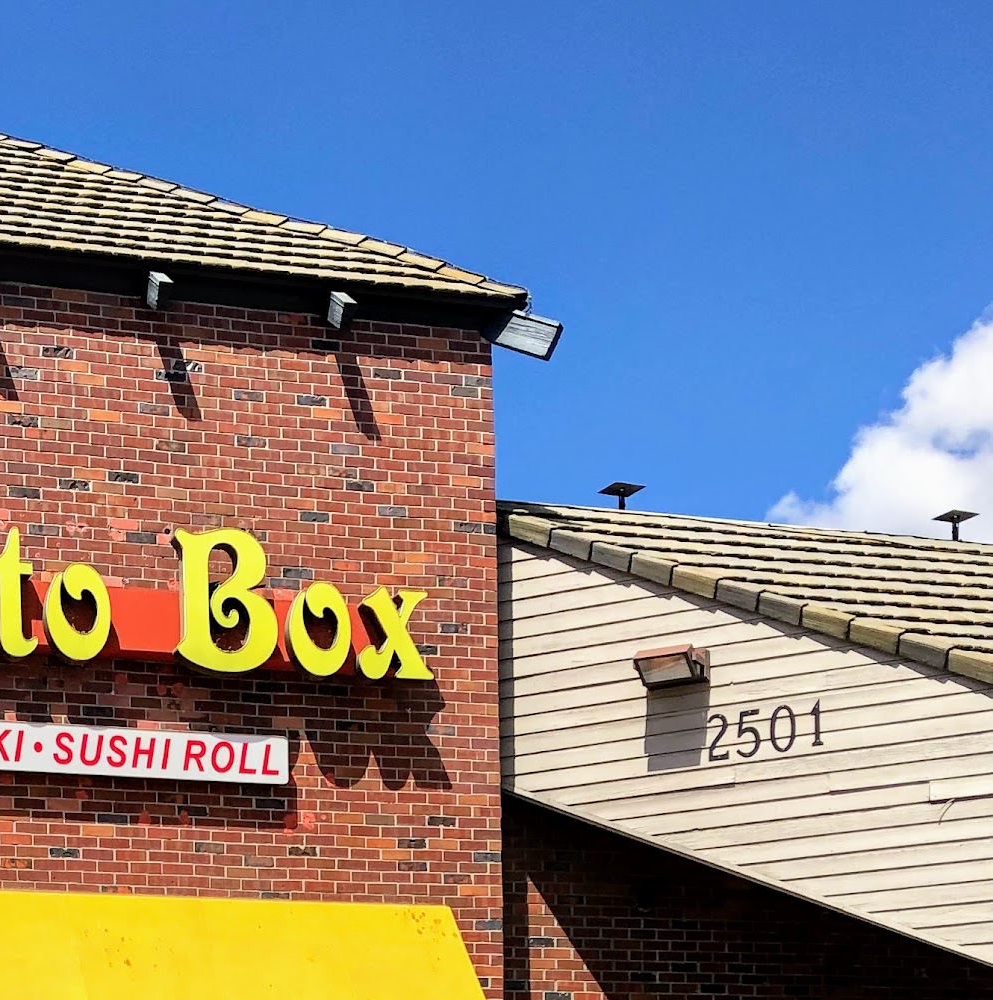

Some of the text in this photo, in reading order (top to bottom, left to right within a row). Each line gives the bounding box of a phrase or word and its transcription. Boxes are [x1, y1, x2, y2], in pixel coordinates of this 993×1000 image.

[172, 526, 435, 682] Box
[53, 732, 171, 770] SUSHI
[183, 741, 280, 776] ROLL
[707, 699, 824, 762] 2501
